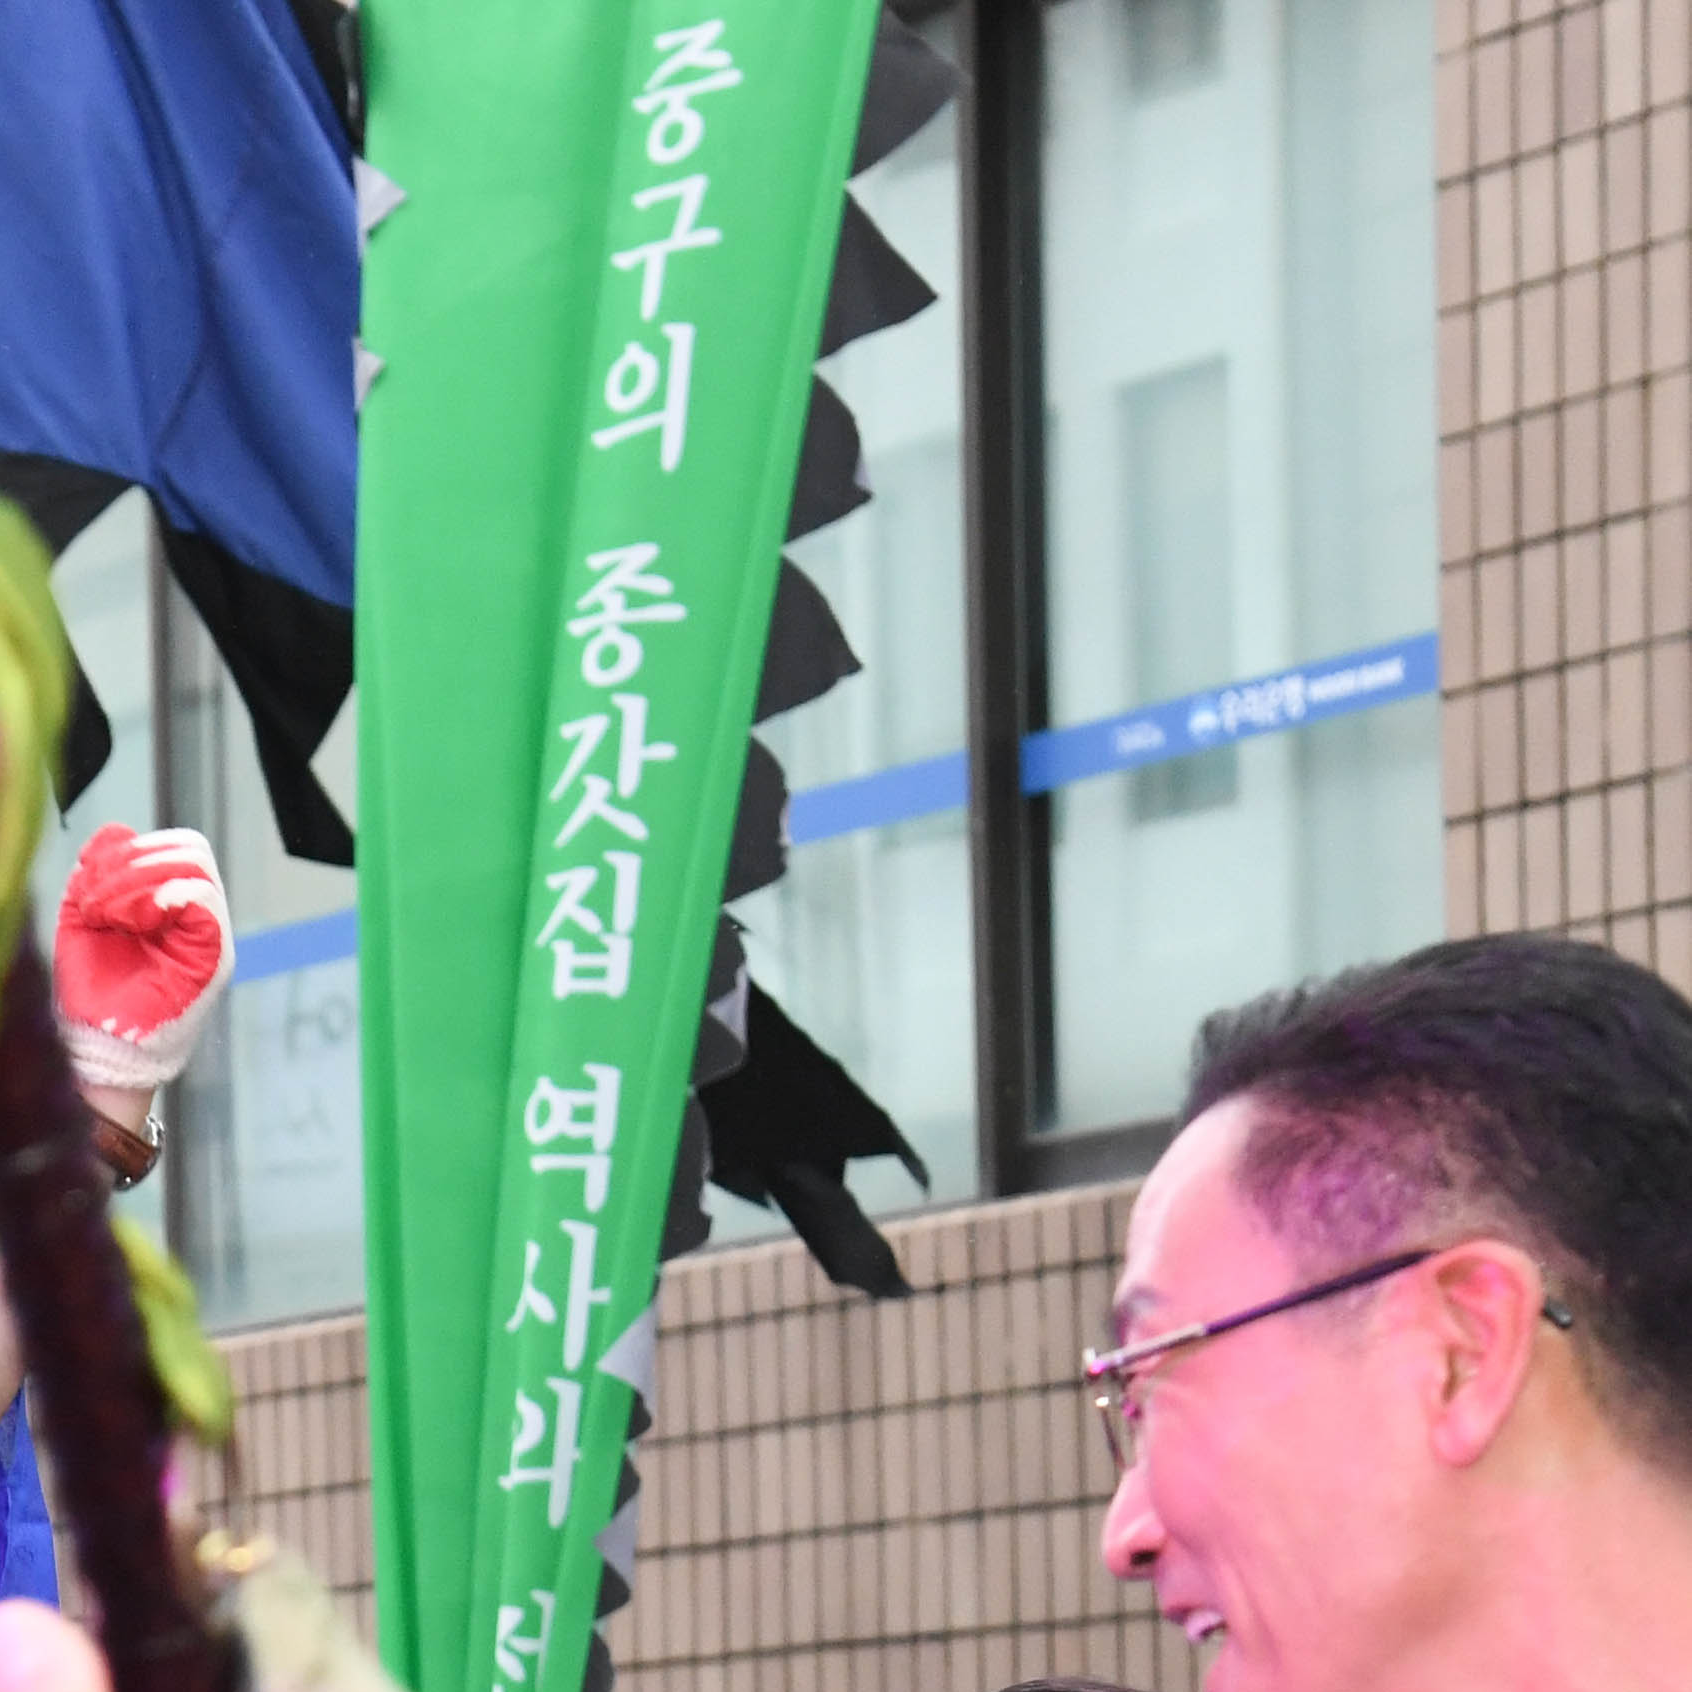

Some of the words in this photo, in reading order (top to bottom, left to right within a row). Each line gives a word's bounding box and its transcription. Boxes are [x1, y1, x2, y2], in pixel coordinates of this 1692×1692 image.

[591, 18, 743, 473] 중구의
[535, 541, 688, 1000] 종갓집
[499, 1061, 622, 1530] 역사와
